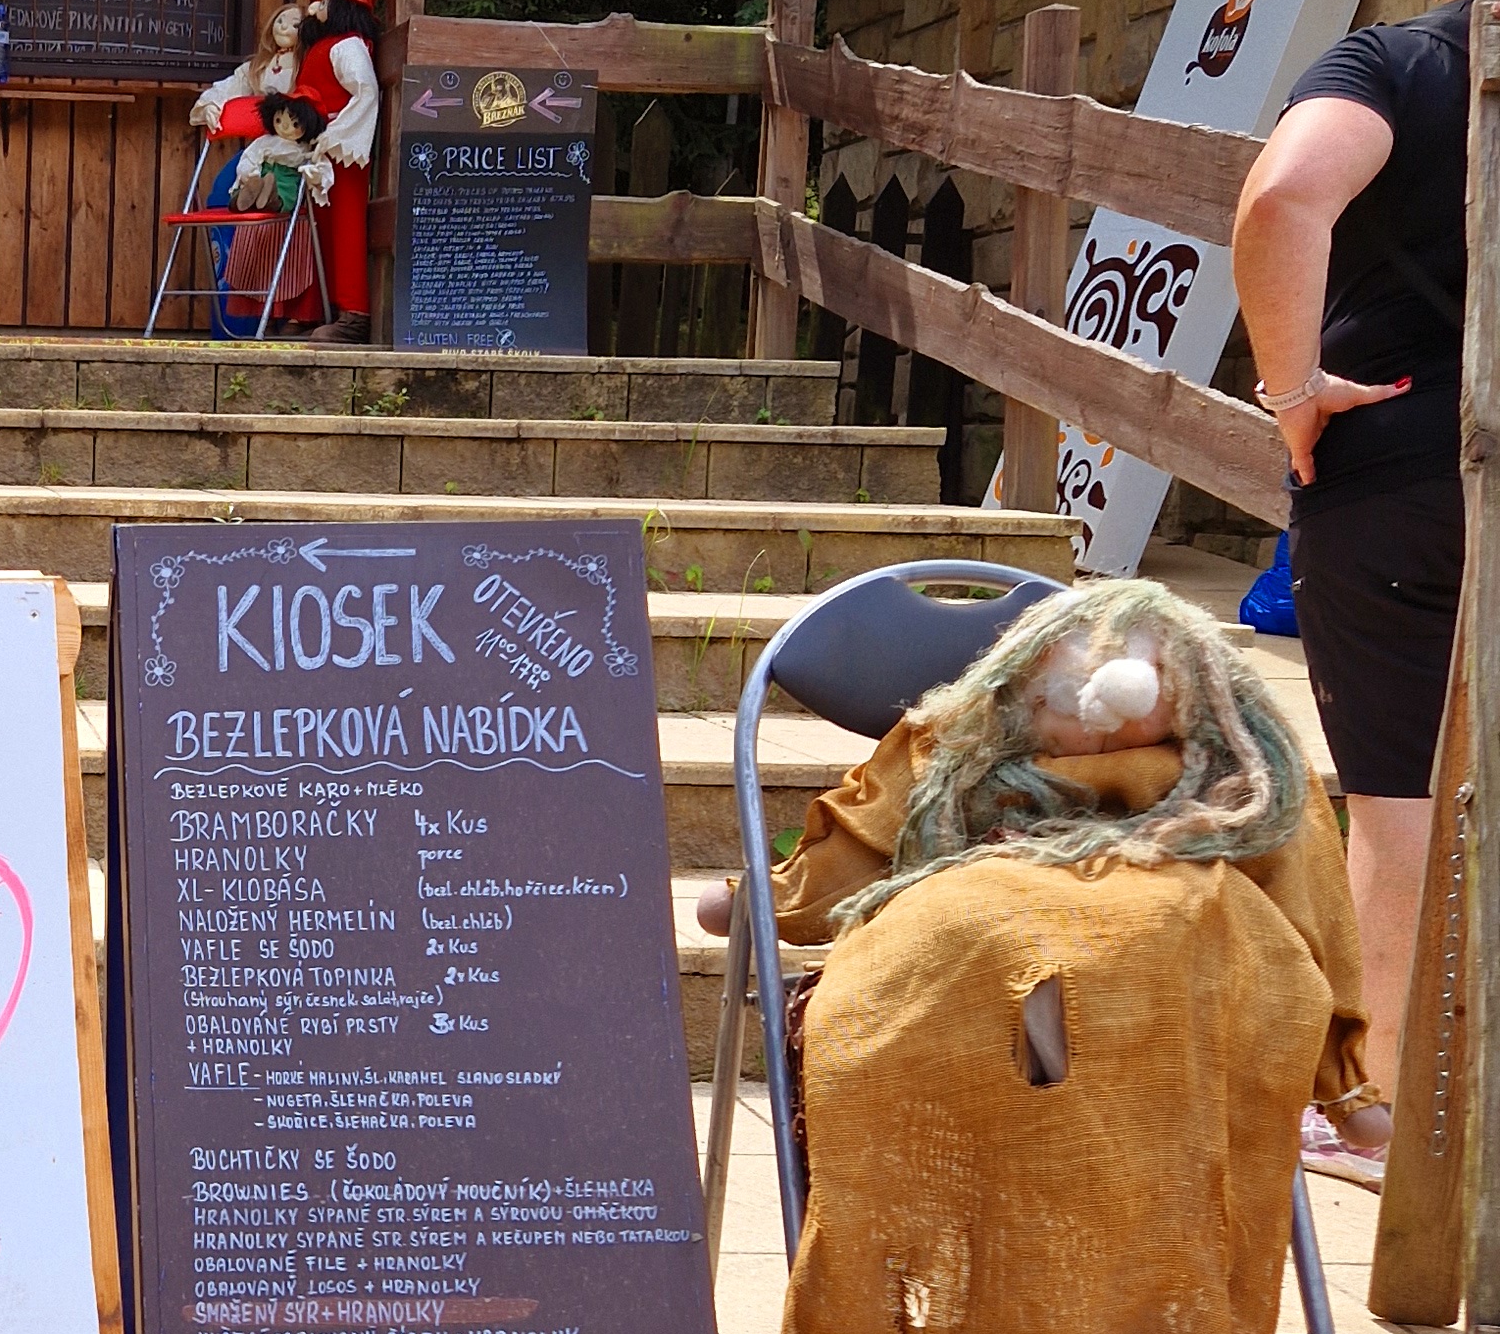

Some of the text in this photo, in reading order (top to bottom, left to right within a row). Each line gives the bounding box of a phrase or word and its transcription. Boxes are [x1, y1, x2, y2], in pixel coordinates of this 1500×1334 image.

[1201, 26, 1239, 60] kofola
[442, 146, 563, 170] PRICE LIST
[417, 332, 494, 347] GLUTEN FREE
[217, 582, 457, 673] KIOSEK
[473, 574, 595, 678] OTEVŘENO
[165, 687, 589, 761] BEZLEPKOVÁ NABÍDKA
[170, 778, 290, 800] BEZLEPKOVÉ
[170, 798, 377, 842] BRAMBORÁČKY
[447, 808, 489, 835] Kus
[174, 845, 463, 872] HRANOLKY porce
[178, 899, 396, 932] NALOŽENÝ HERMELÍN
[180, 938, 242, 961] VAFLE
[259, 939, 279, 959] SE
[289, 933, 335, 959] ŠODO
[182, 960, 304, 988] BEZLEPKOVÁ
[309, 967, 396, 987] TOPINKA
[185, 1009, 294, 1035] OBALOVANÉ
[300, 1012, 338, 1034] RYBÍ
[346, 1016, 399, 1034] PRSTY
[188, 1062, 251, 1086] VAFLE
[418, 1094, 474, 1107] POLEVA
[418, 1115, 477, 1129] POLEVA
[189, 1143, 398, 1171] BUCHTIČKY SE ŠODO
[192, 1181, 309, 1202] BROWNIES
[194, 1207, 299, 1226] HRANOLKY
[307, 1203, 371, 1224] SYPANÉ
[474, 1207, 485, 1222] A
[490, 1202, 563, 1221] SÝROVOU
[193, 1231, 289, 1250] HRANOLKY
[296, 1228, 365, 1249] SYPANÉ
[476, 1231, 487, 1246] A
[492, 1230, 566, 1245] KEČUPEM
[572, 1231, 616, 1244] NEBO
[619, 1229, 690, 1243] TATARKOU
[194, 1250, 468, 1272] OBALOVANÉ FILE HRANOLKY
[194, 1275, 481, 1297] OBALOVANÝ LOSOS HRANOLKY
[193, 1297, 279, 1325] SMAŽENÝ
